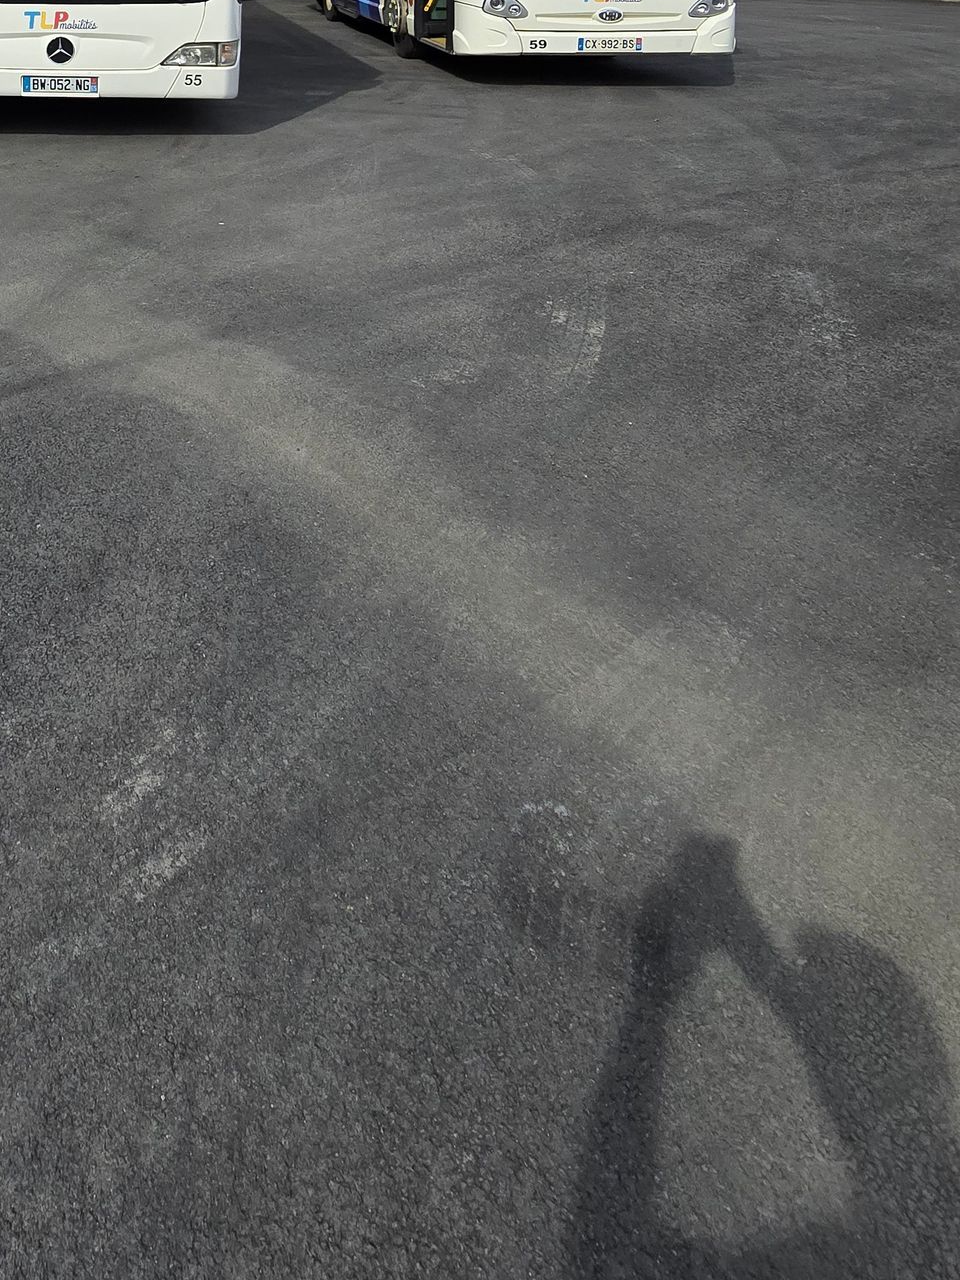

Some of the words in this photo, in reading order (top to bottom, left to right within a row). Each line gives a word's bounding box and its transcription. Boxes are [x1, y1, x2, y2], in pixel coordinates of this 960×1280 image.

[23, 11, 69, 30] TLP
[59, 19, 98, 30] mobilités
[529, 39, 547, 50] 59
[584, 39, 635, 49] CX-992-BS
[32, 77, 90, 91] BW-052-NG
[184, 74, 202, 87] 55
